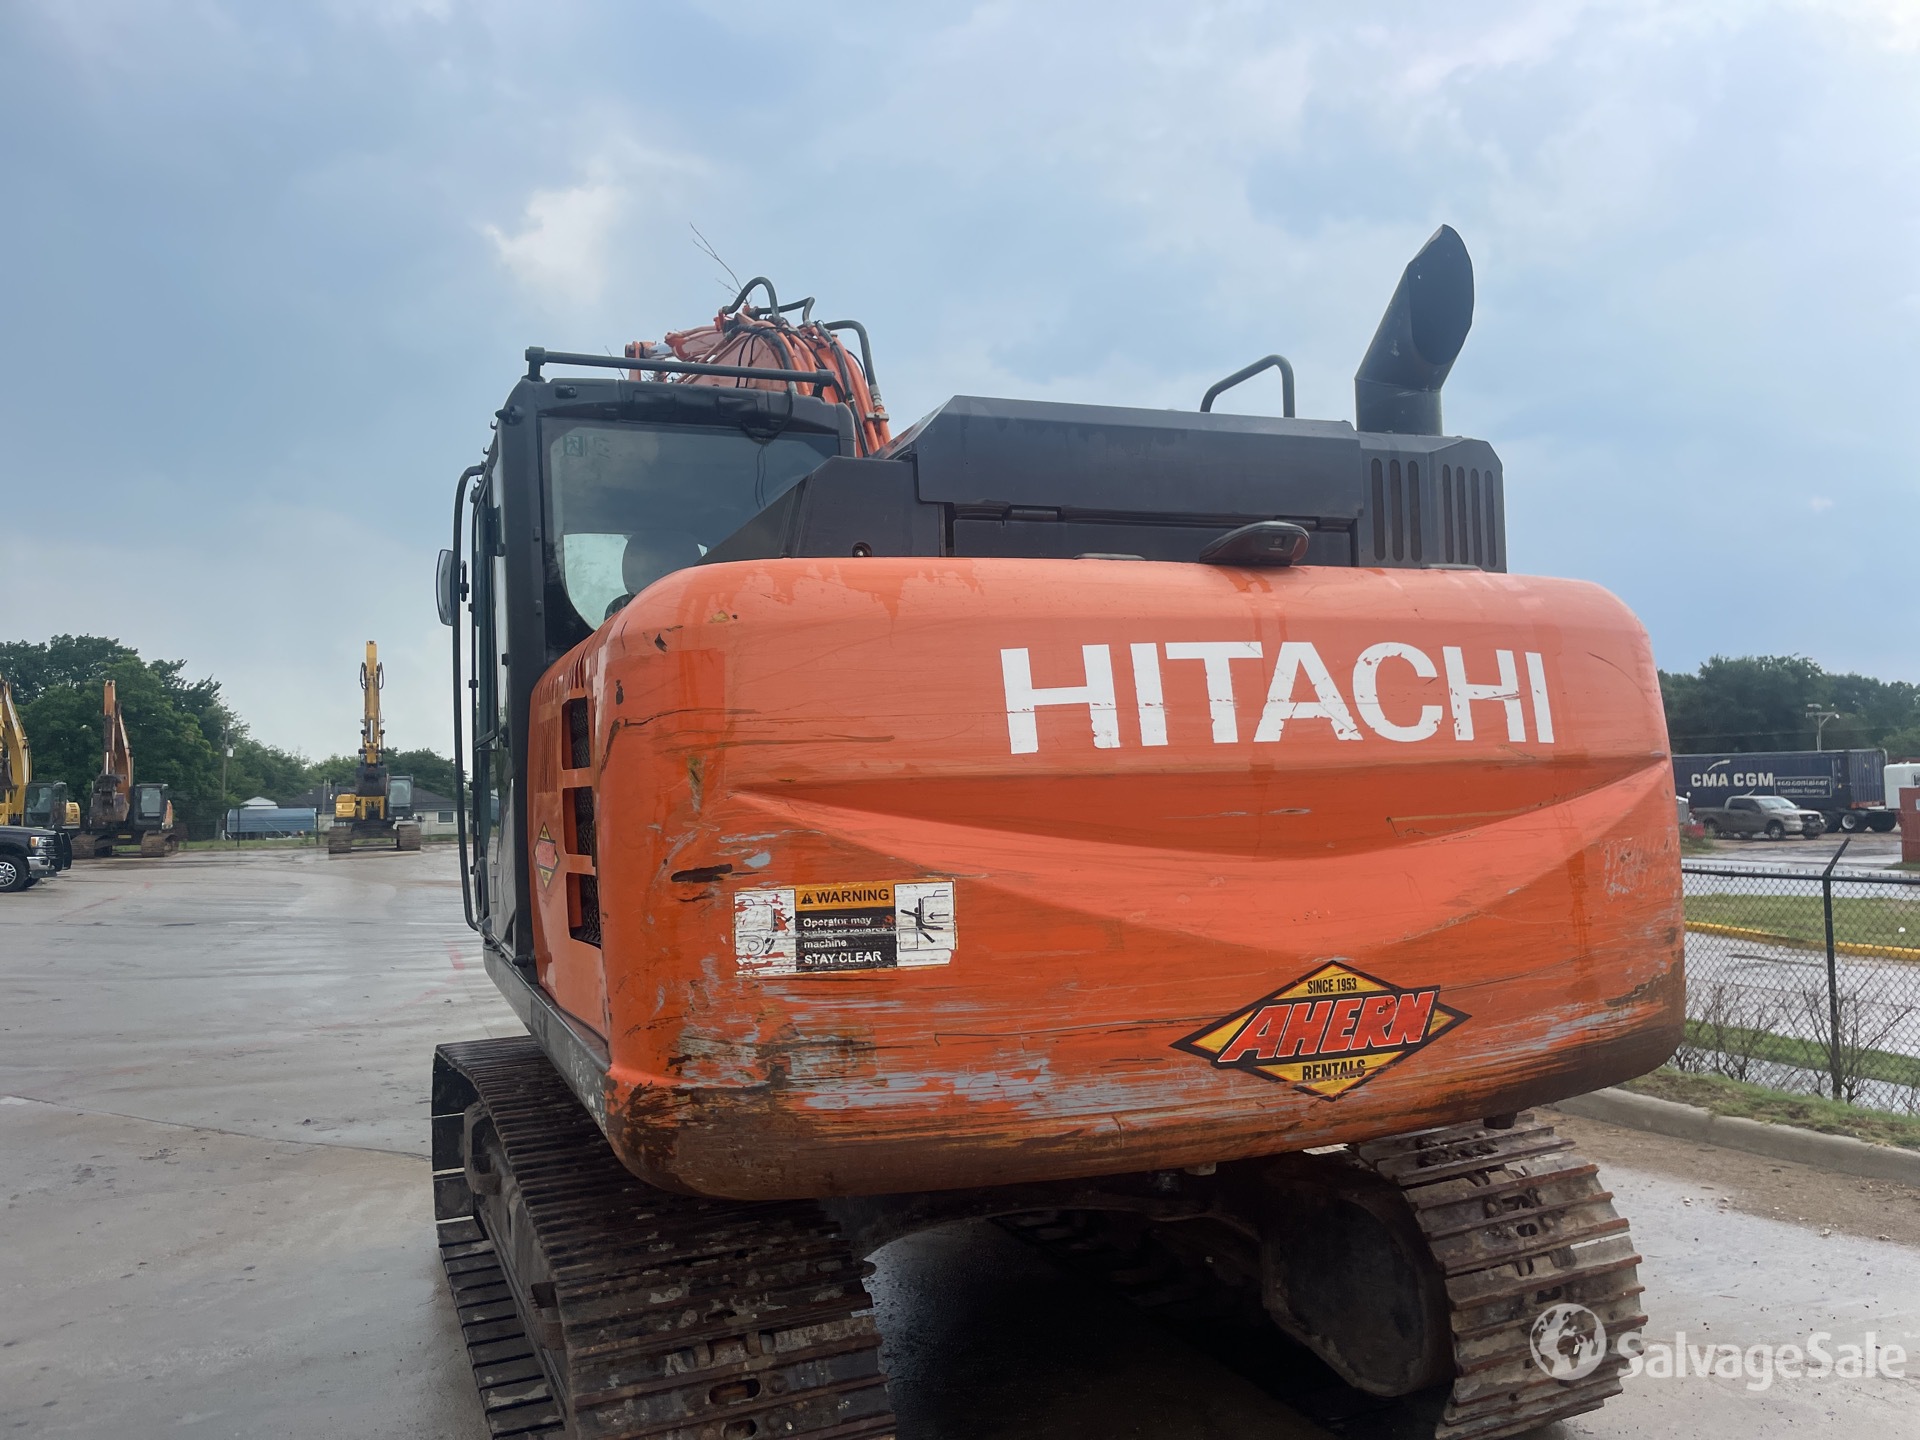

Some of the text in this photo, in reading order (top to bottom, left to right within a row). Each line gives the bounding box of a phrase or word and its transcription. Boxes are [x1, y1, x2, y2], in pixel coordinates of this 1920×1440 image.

[1000, 641, 1555, 754] HITACHI
[1691, 772, 1774, 787] CMA CGM
[816, 889, 889, 904] WARNING
[803, 917, 872, 928] Operator may
[804, 938, 847, 949] machine
[804, 951, 882, 965] STAY CLEAR
[1307, 977, 1357, 994] SINCE 1953
[1217, 990, 1435, 1063] AHERN
[1302, 1059, 1366, 1081] RENTALS
